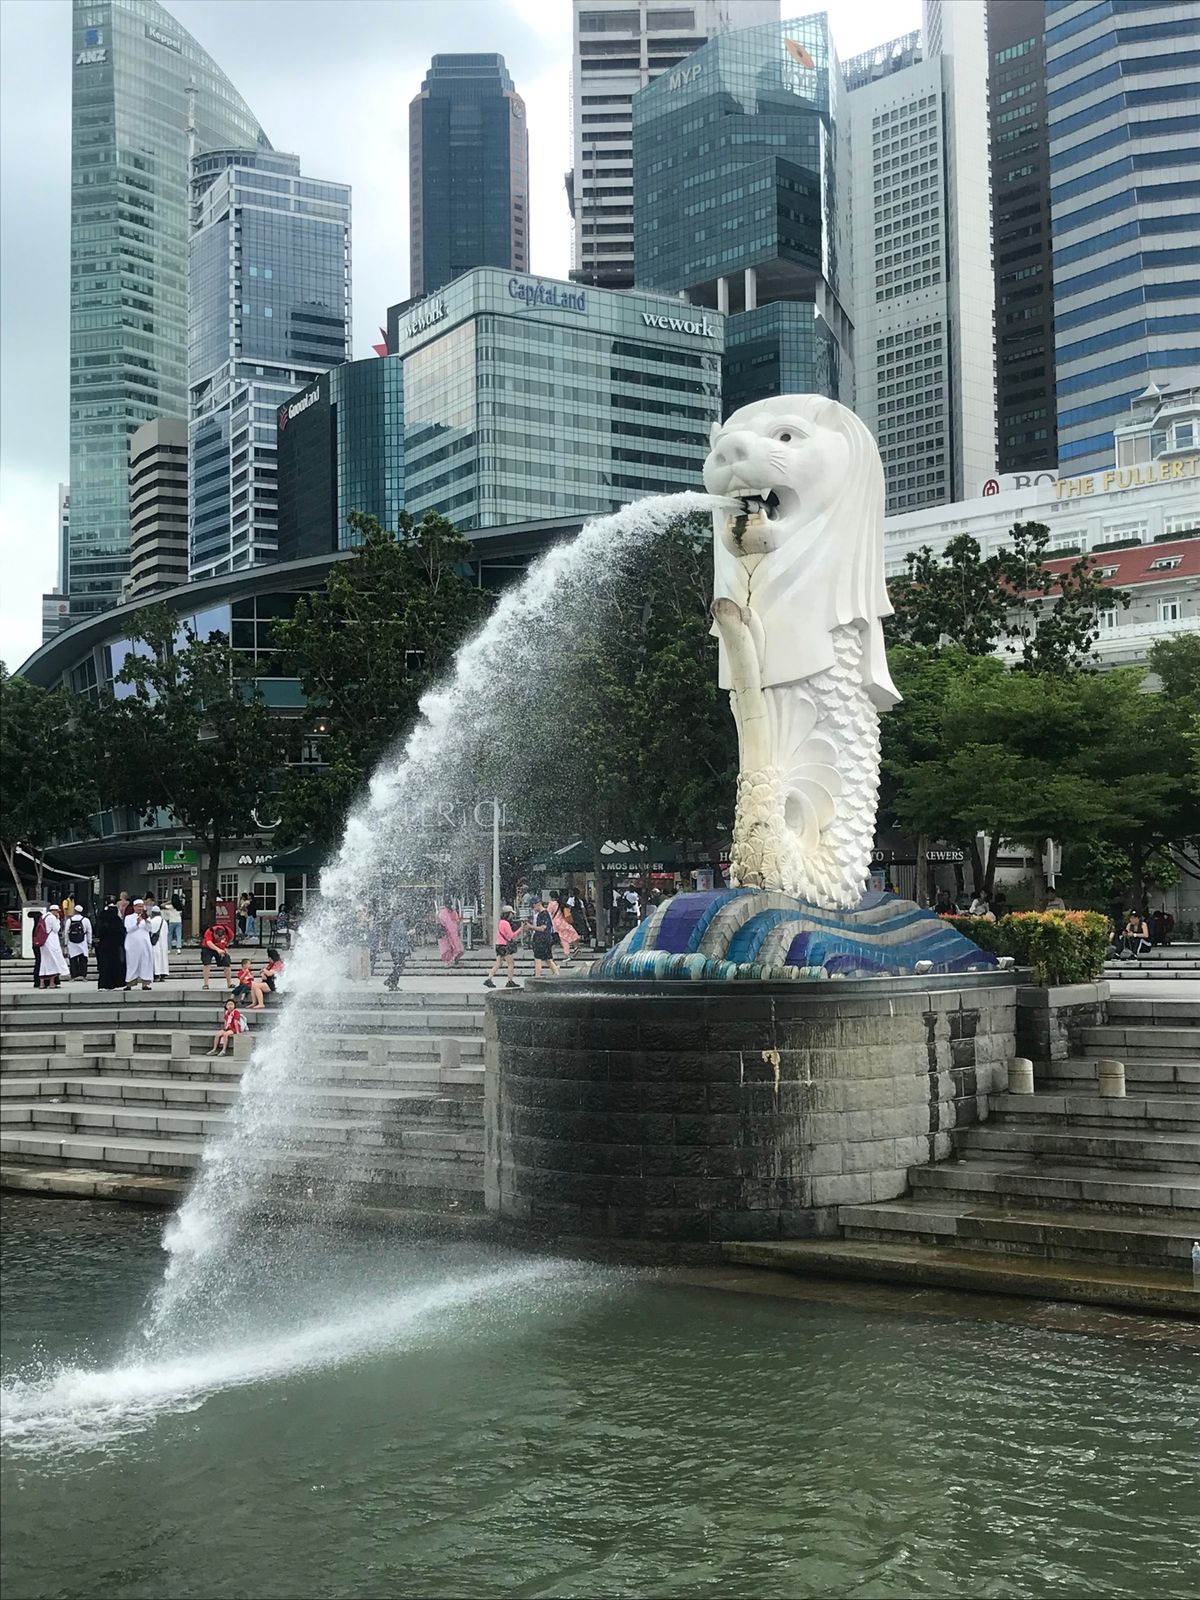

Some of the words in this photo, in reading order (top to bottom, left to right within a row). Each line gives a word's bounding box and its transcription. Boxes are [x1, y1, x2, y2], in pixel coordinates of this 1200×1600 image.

[149, 26, 181, 50] Keppel
[75, 49, 106, 65] ANZ
[669, 64, 702, 91] MYP
[508, 277, 586, 311] CapitaLand
[405, 298, 448, 338] wework
[641, 312, 717, 337] wework
[1054, 476, 1095, 499] THE
[606, 862, 628, 870] MOS
